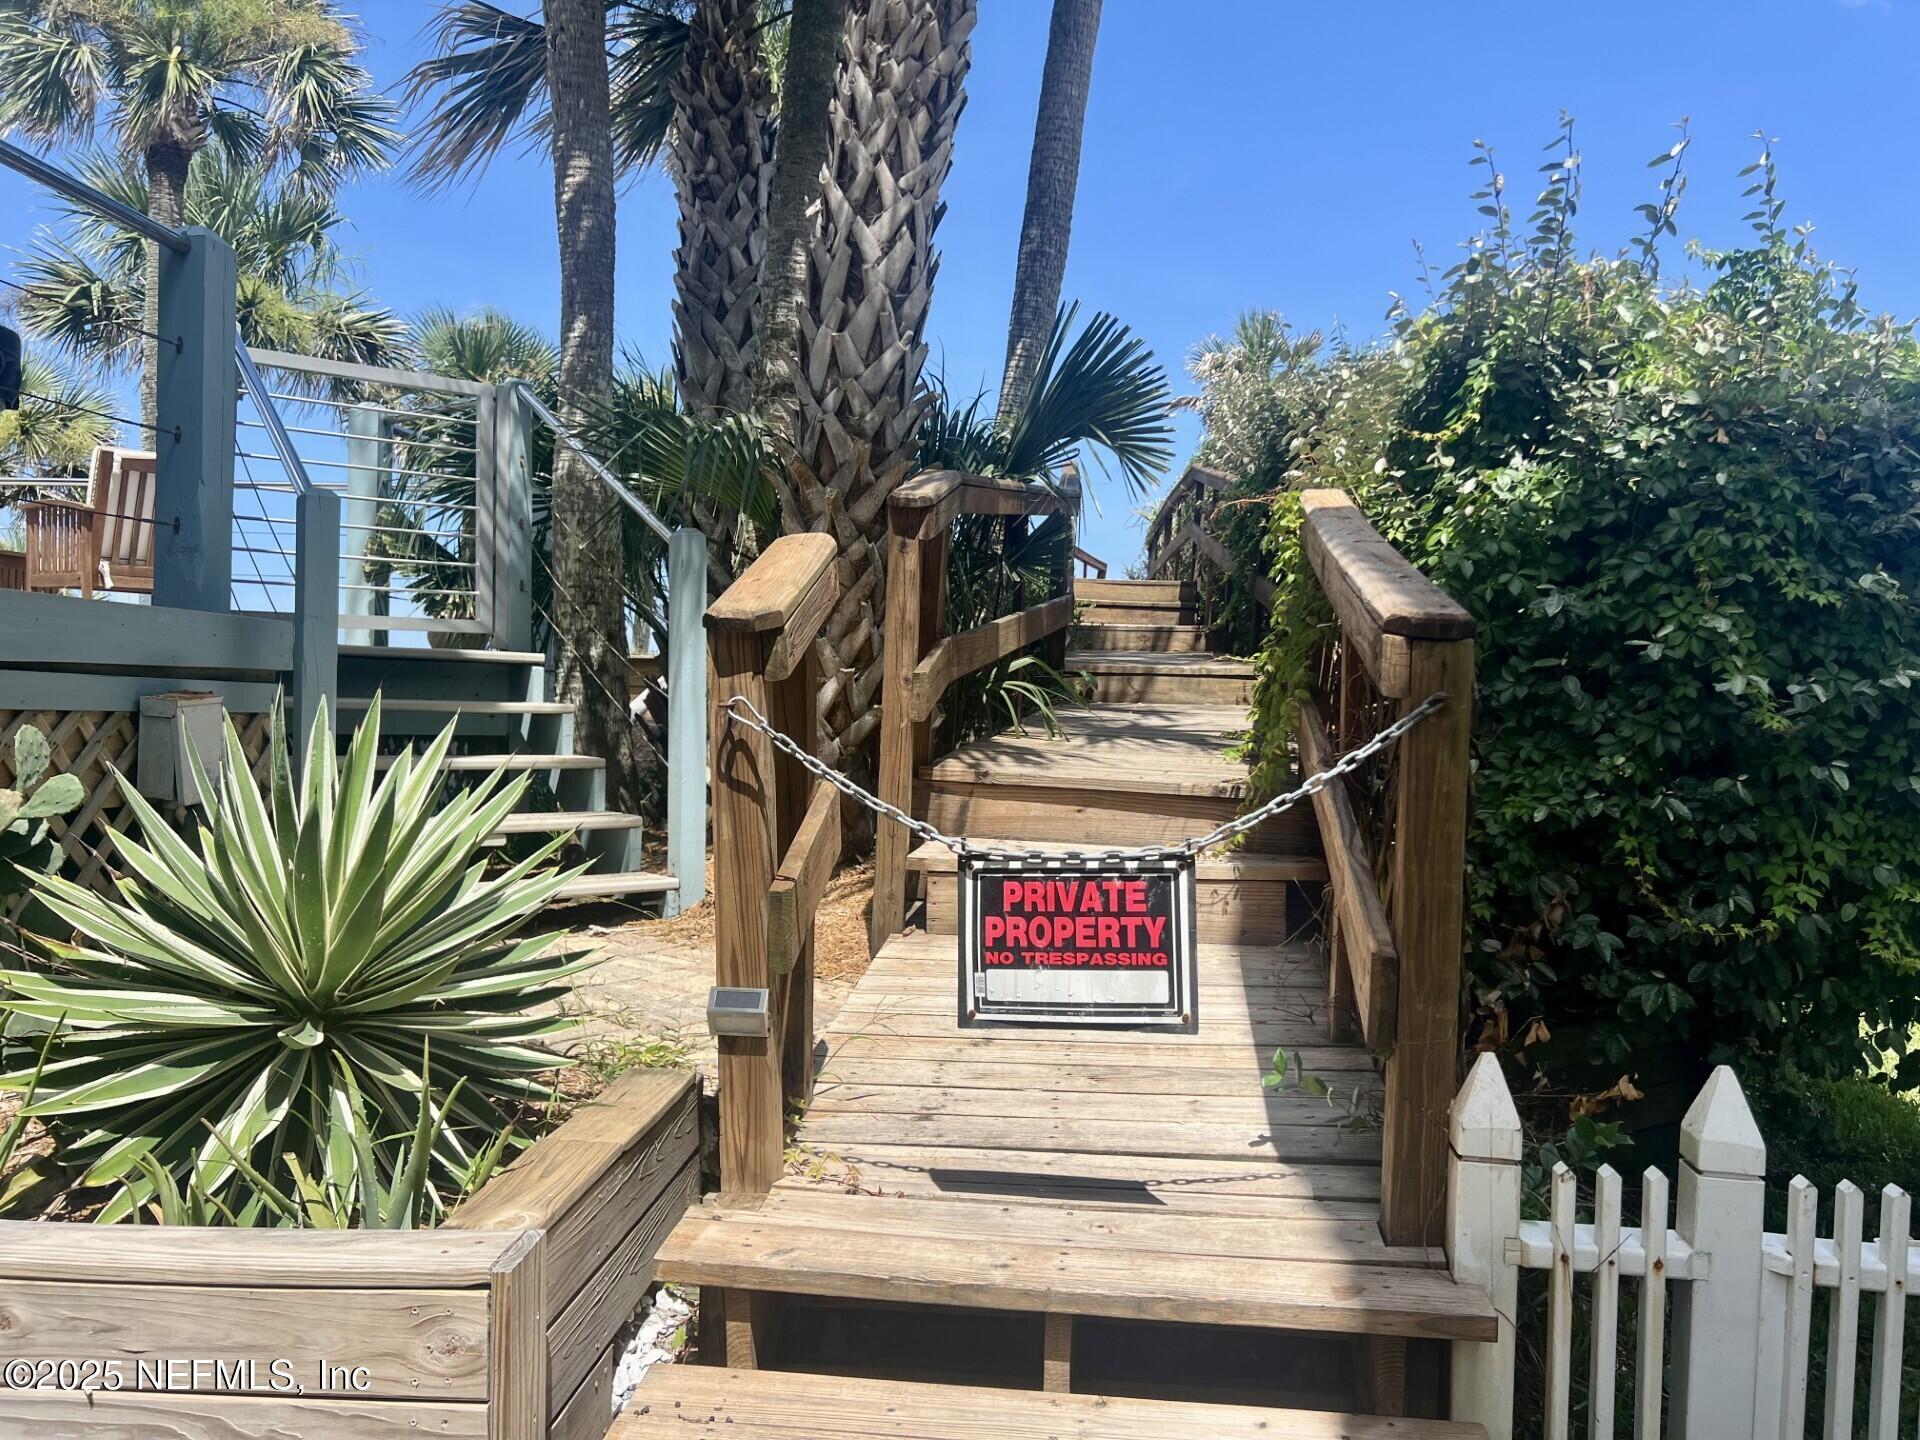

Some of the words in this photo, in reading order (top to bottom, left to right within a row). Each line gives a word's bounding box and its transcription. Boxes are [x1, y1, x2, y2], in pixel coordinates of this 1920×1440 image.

[1003, 880, 1148, 912] PRIVATE
[984, 915, 1166, 948] PROPERTY
[985, 951, 1016, 965] NO
[1021, 951, 1169, 966] TRESPASSING
